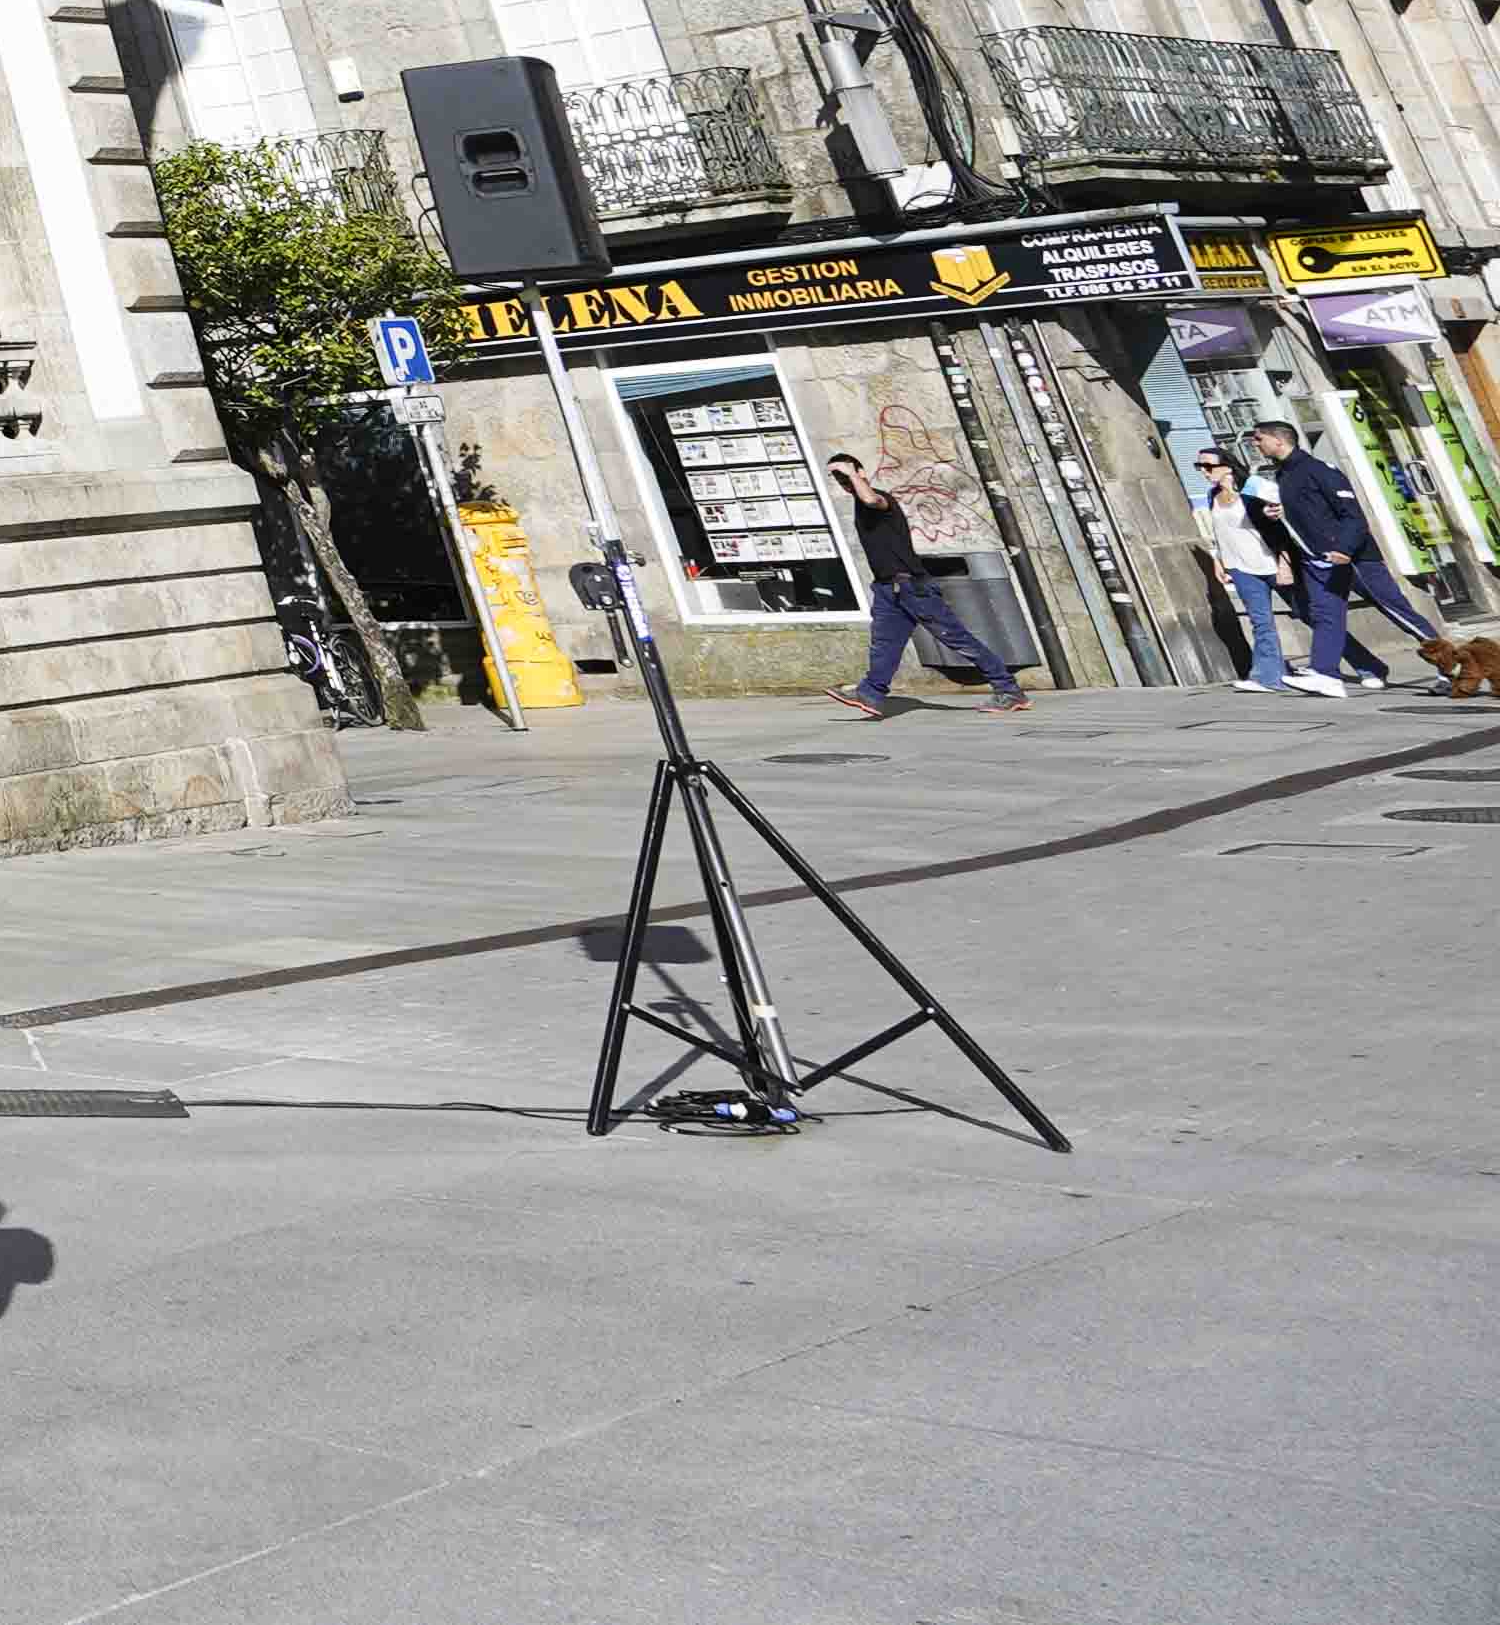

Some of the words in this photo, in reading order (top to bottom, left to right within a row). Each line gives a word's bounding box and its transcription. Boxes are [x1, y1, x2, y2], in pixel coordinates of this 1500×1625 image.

[1042, 239, 1155, 265] ALQUILERES
[746, 258, 859, 287] GESTION
[1049, 258, 1160, 283] TRASPASOS
[1164, 276, 1182, 288] 11
[728, 278, 903, 312] INMOBILIARIA
[1364, 302, 1423, 326] ATM
